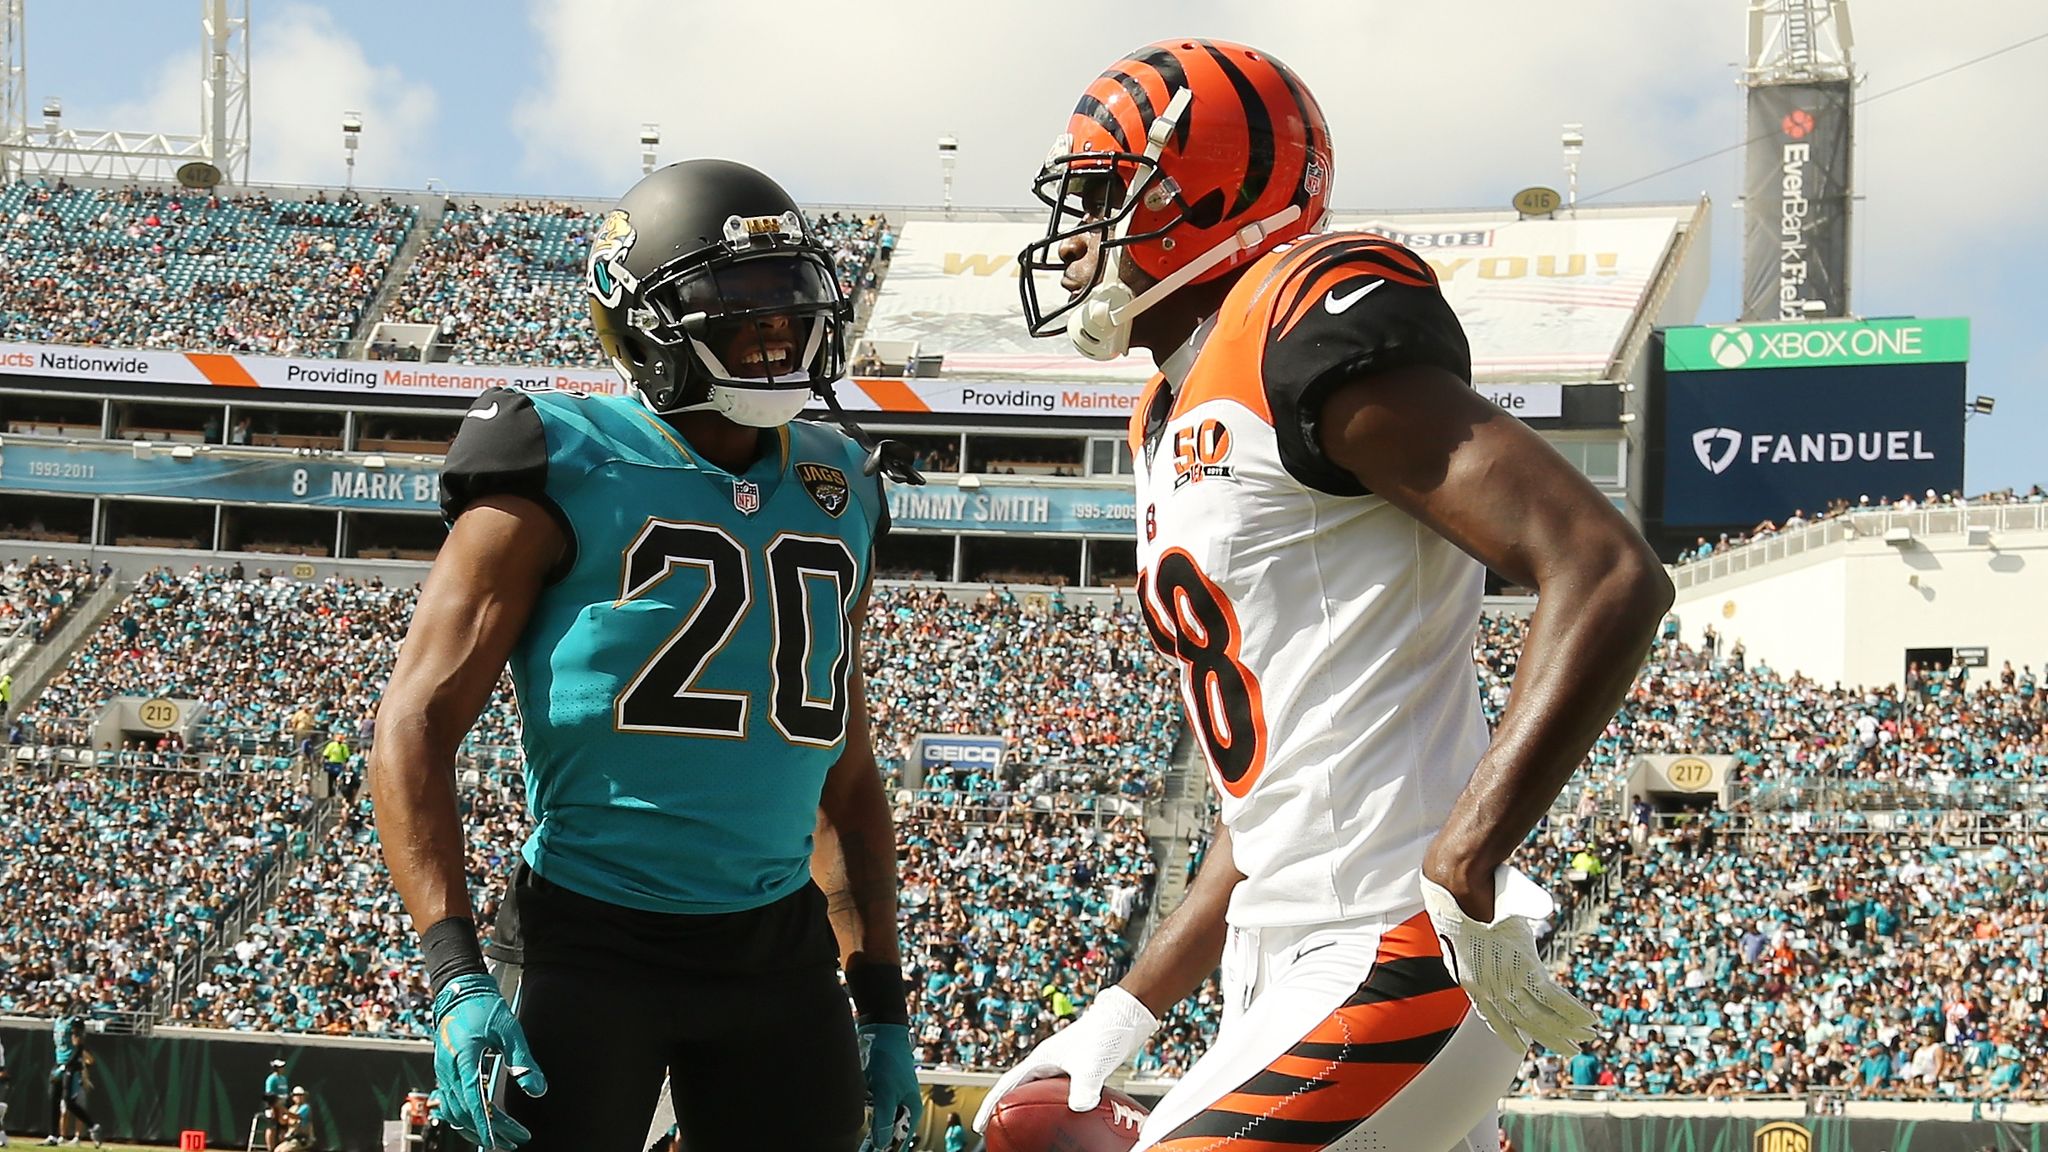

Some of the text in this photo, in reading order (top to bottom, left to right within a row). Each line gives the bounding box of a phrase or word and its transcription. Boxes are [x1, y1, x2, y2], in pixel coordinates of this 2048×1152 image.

[1523, 193, 1550, 208] 416
[1781, 143, 1810, 260] EverBank
[744, 217, 781, 234] JAGS
[1428, 253, 1618, 281] YOU!
[1759, 327, 1923, 359] XBOX ONE
[40, 353, 149, 374] Nationwide
[287, 365, 377, 388] Providing
[384, 369, 508, 390] Maintenance
[514, 377, 549, 389] and
[556, 376, 617, 394] Repair
[962, 388, 1140, 411] Providing Mainten
[1173, 418, 1230, 475] 50
[1751, 430, 1934, 464] FANDUEL
[28, 461, 95, 479] 1993-2011
[803, 465, 846, 485] JAGS
[292, 468, 308, 496] 8
[331, 471, 405, 500] MARK
[736, 493, 756, 507] NFL
[890, 492, 968, 520] JIMMY
[974, 494, 1049, 523] SMITH
[613, 516, 858, 748] 20
[146, 705, 172, 721] 213
[924, 744, 1001, 763] GEICO
[1675, 765, 1703, 781] 217
[186, 1134, 201, 1149] 10
[1761, 1129, 1807, 1152] JAGS
